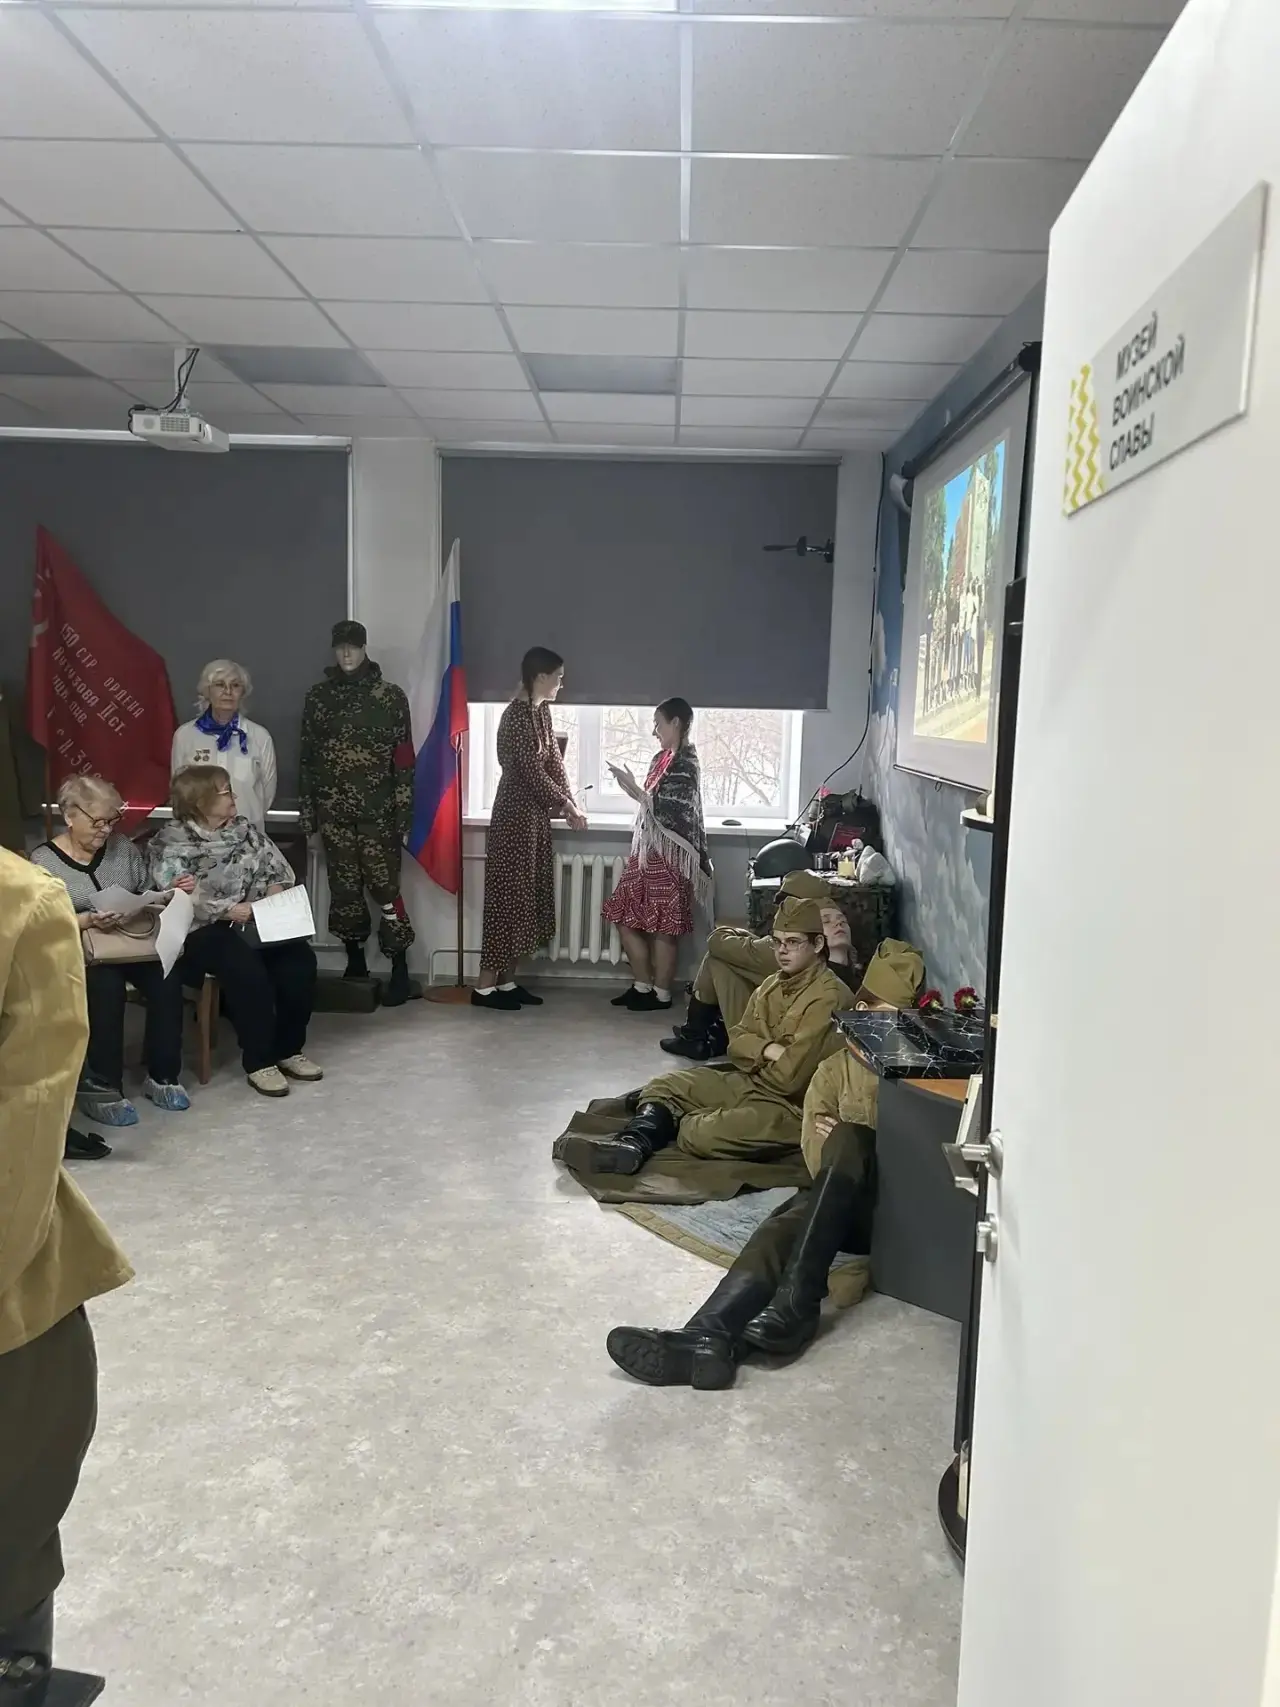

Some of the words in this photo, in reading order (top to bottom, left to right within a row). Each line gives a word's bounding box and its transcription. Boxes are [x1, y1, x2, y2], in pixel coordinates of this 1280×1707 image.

[1112, 333, 1187, 427] ВОИНСКОЙ
[1115, 310, 1159, 383] МУЗЕЙ
[1109, 413, 1155, 470] СЛАВЫ
